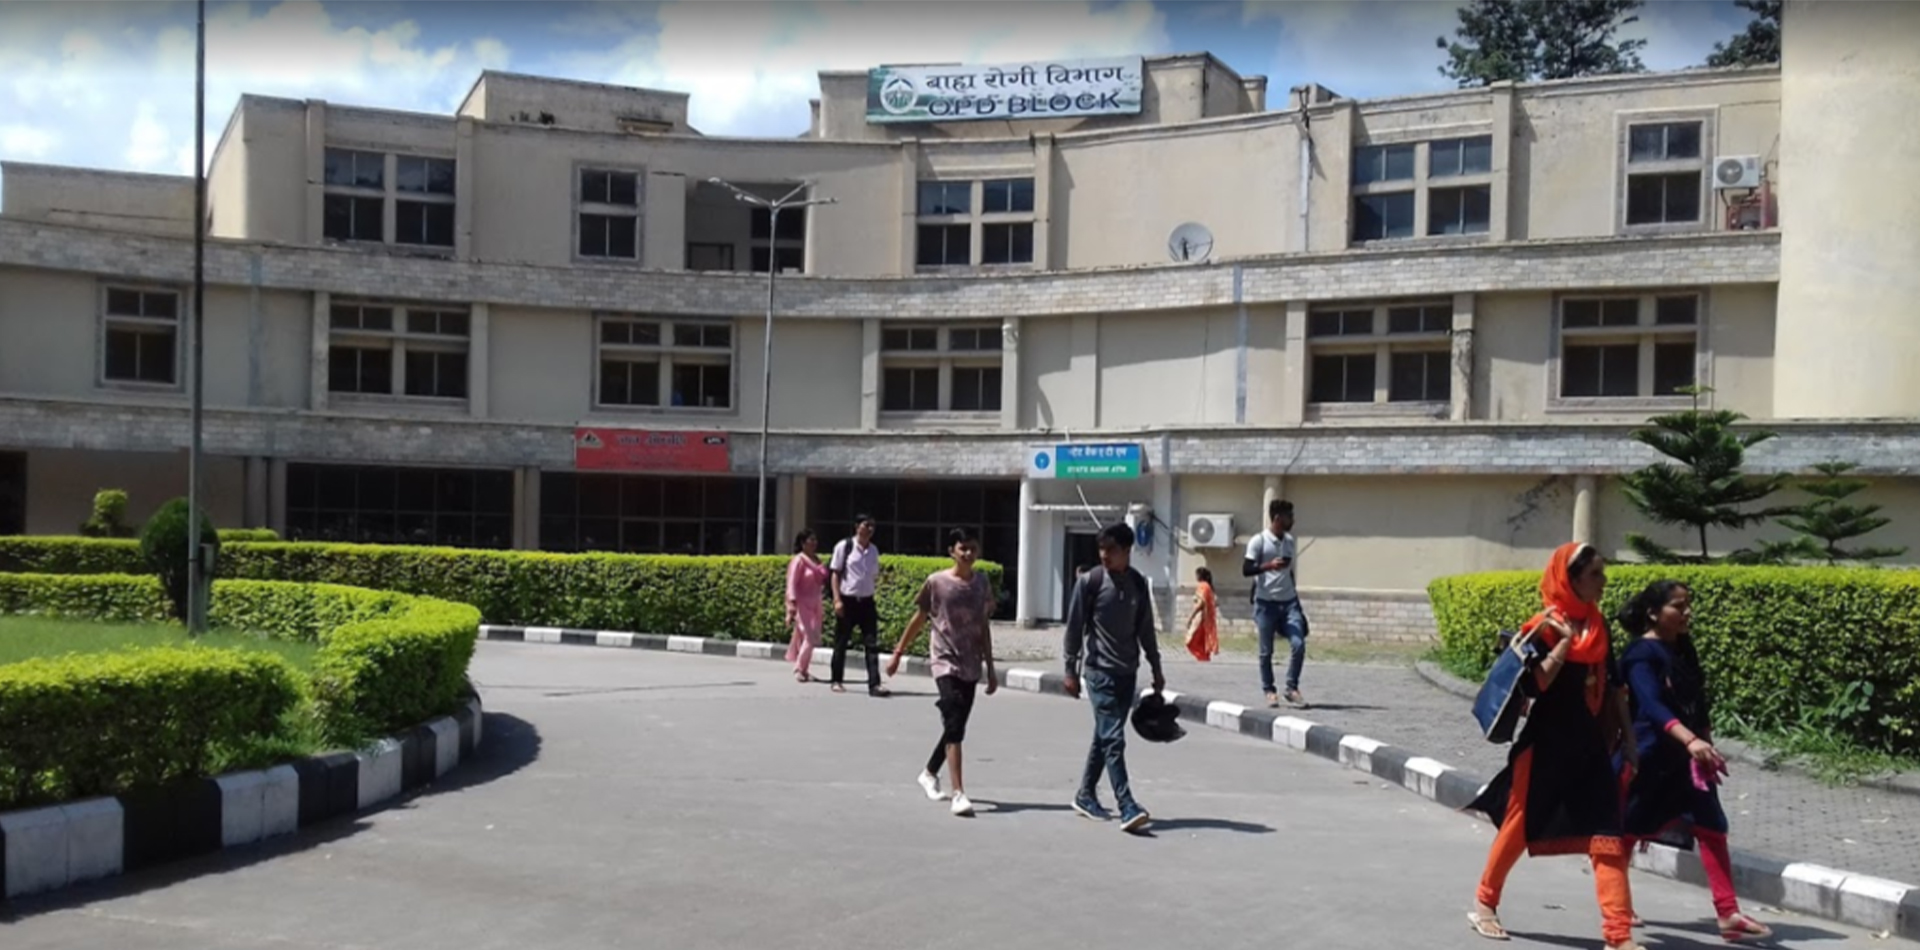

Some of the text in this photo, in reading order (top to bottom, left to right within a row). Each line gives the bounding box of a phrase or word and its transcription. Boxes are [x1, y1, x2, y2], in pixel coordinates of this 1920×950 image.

[983, 65, 1038, 88] रोगी
[1046, 64, 1124, 86] विभाग
[928, 91, 1120, 116] OPD BLOCK
